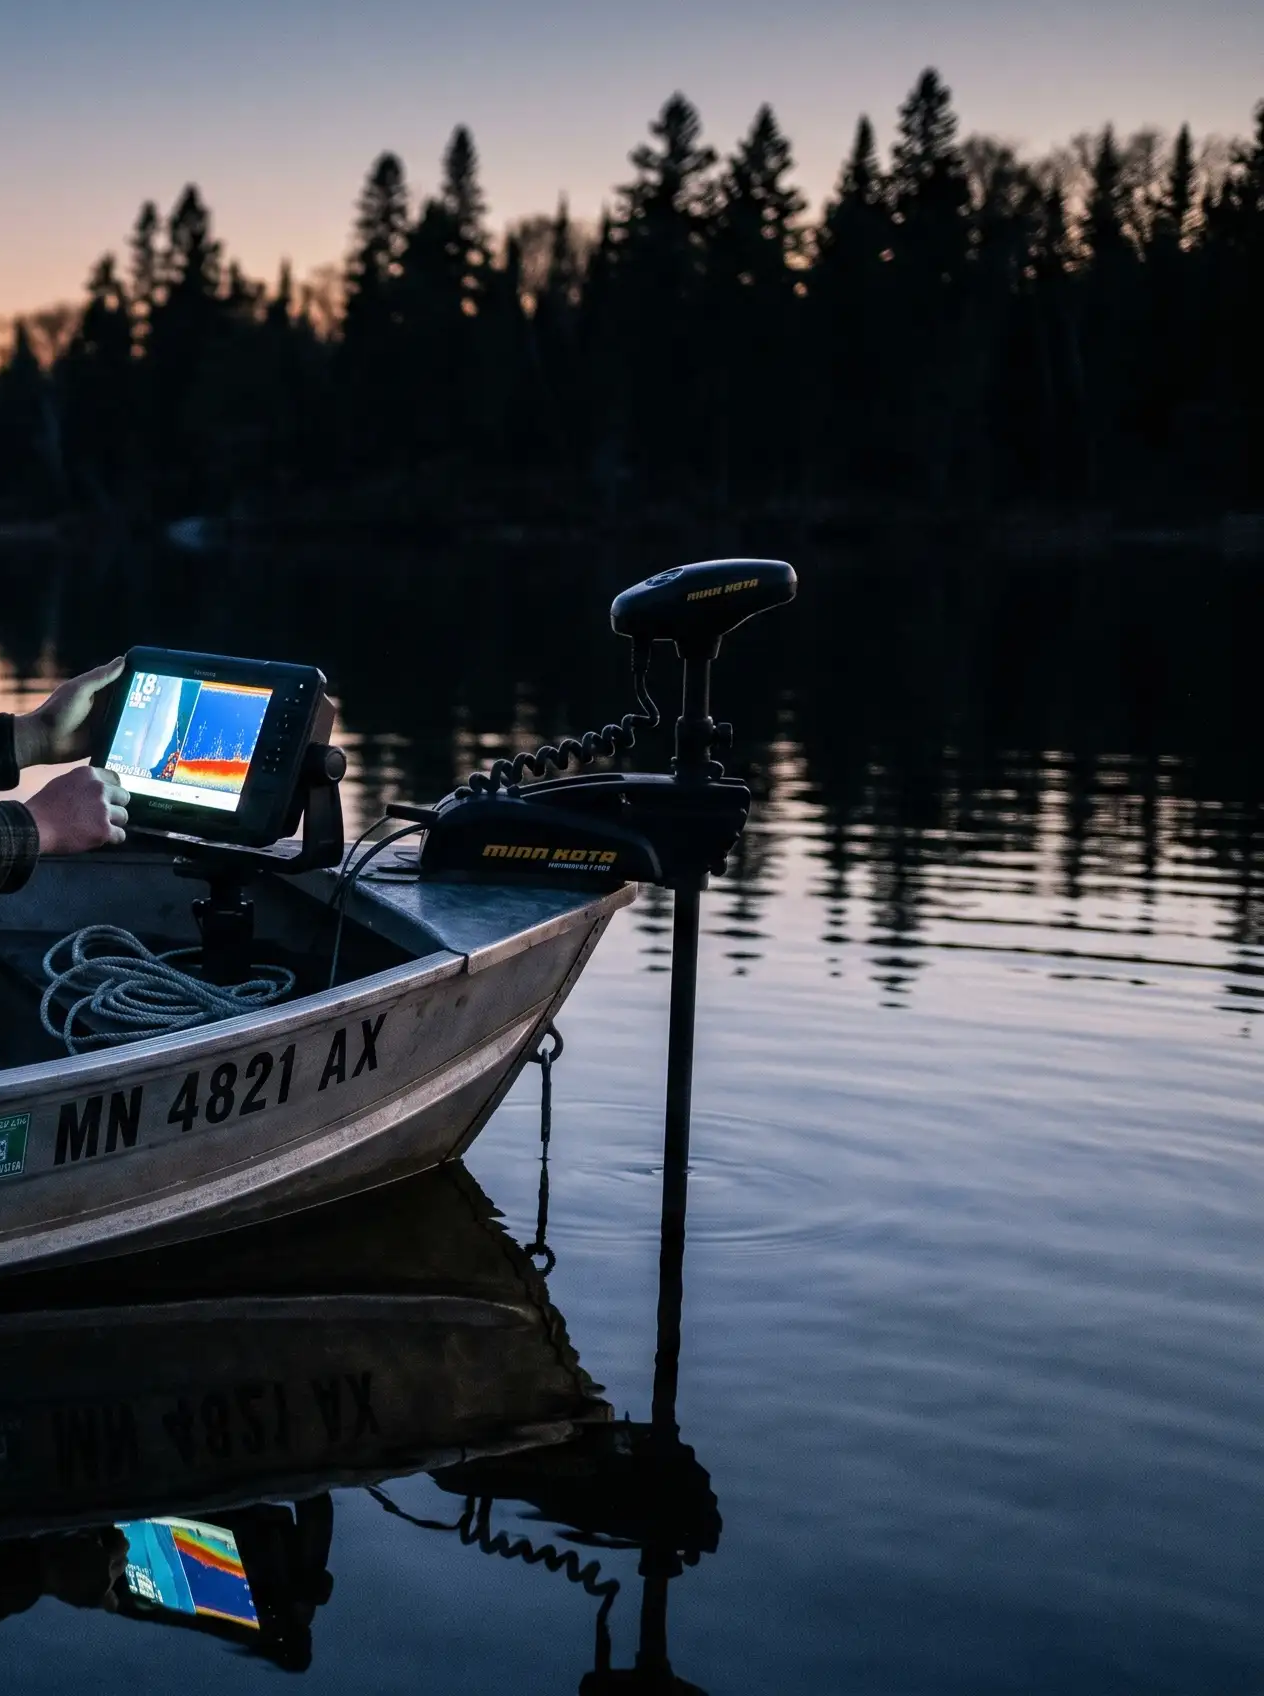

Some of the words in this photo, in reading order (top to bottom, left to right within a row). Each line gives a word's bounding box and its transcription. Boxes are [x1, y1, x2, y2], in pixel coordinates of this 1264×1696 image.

[482, 843, 550, 860] MINN
[551, 848, 618, 863] KOTA
[53, 1085, 143, 1165] MN
[167, 1043, 296, 1132] 4821
[318, 1013, 388, 1092] AX
